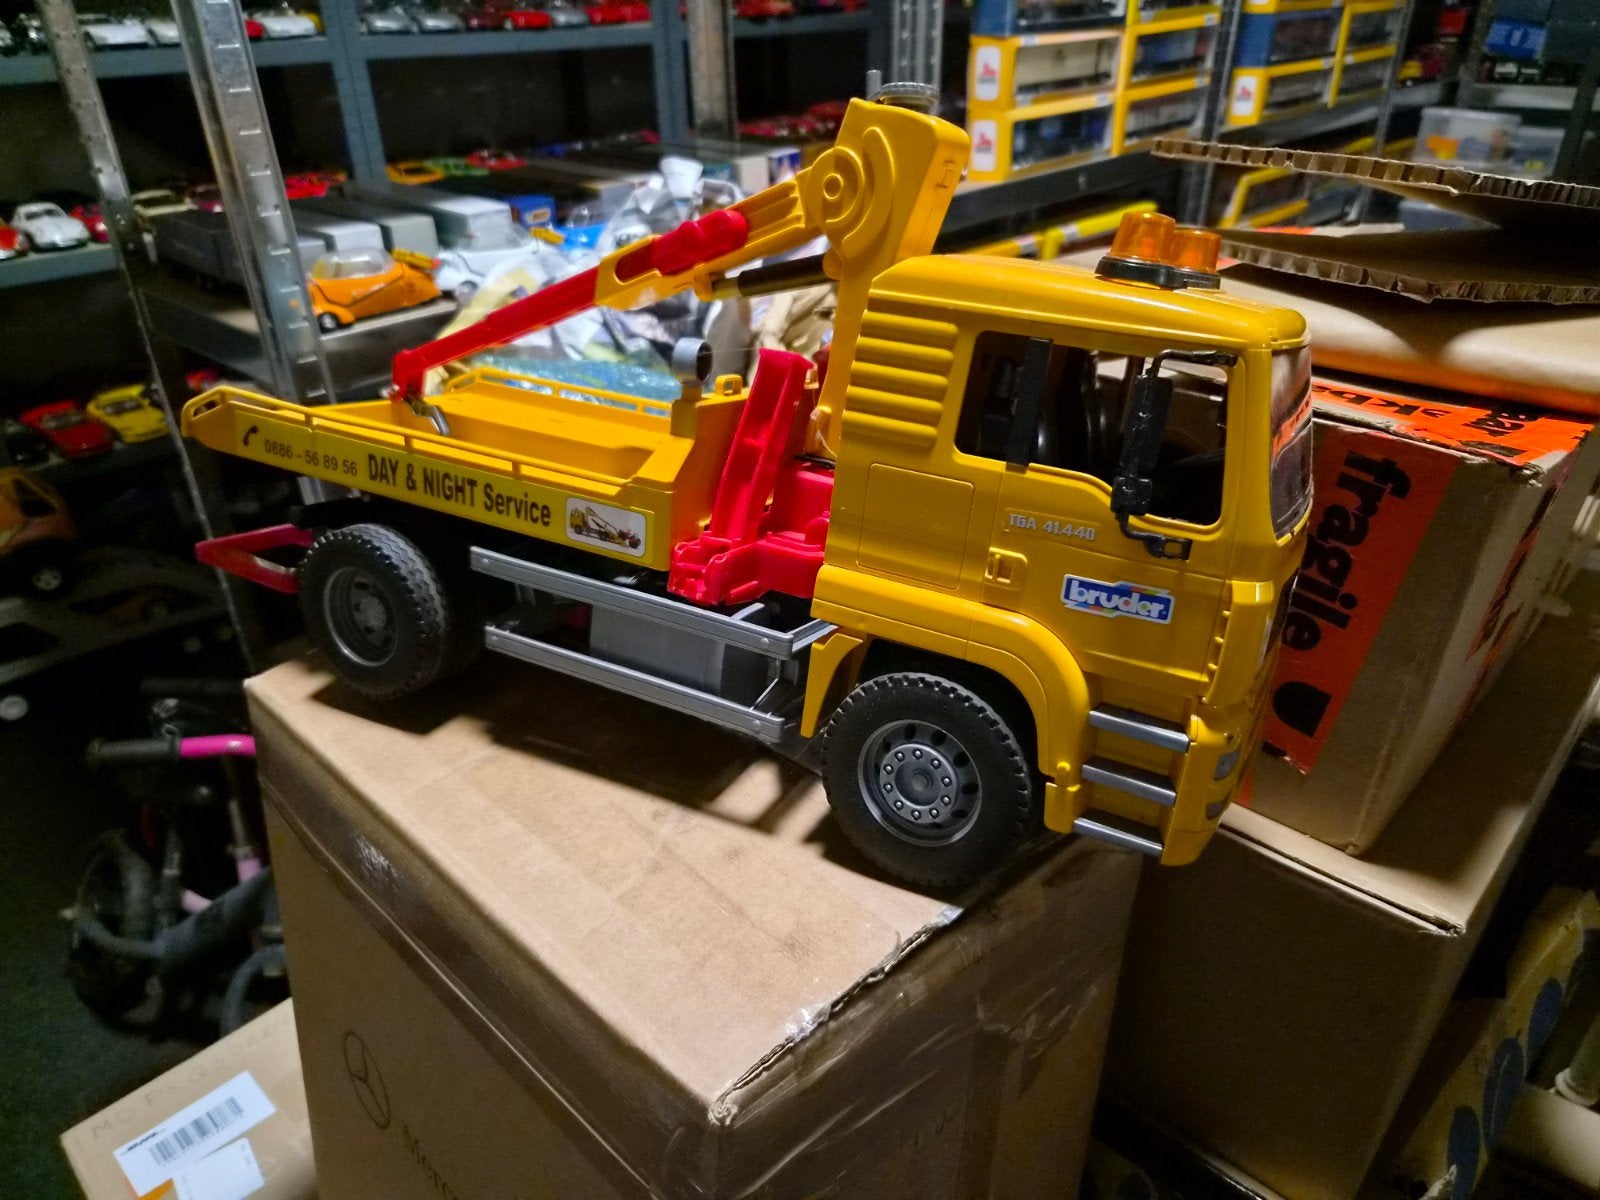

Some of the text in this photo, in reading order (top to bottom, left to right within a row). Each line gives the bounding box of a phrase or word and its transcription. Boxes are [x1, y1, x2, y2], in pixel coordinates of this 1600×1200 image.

[305, 450, 319, 466] 56
[323, 454, 338, 471] 89
[342, 459, 358, 476] 56
[368, 453, 399, 487] DAY
[405, 463, 418, 492] &
[423, 467, 478, 508] NIGHT
[483, 482, 552, 527] Service
[1009, 513, 1096, 541] TGA 41.440
[1279, 449, 1412, 651] fragile
[1069, 579, 1167, 619] bruder
